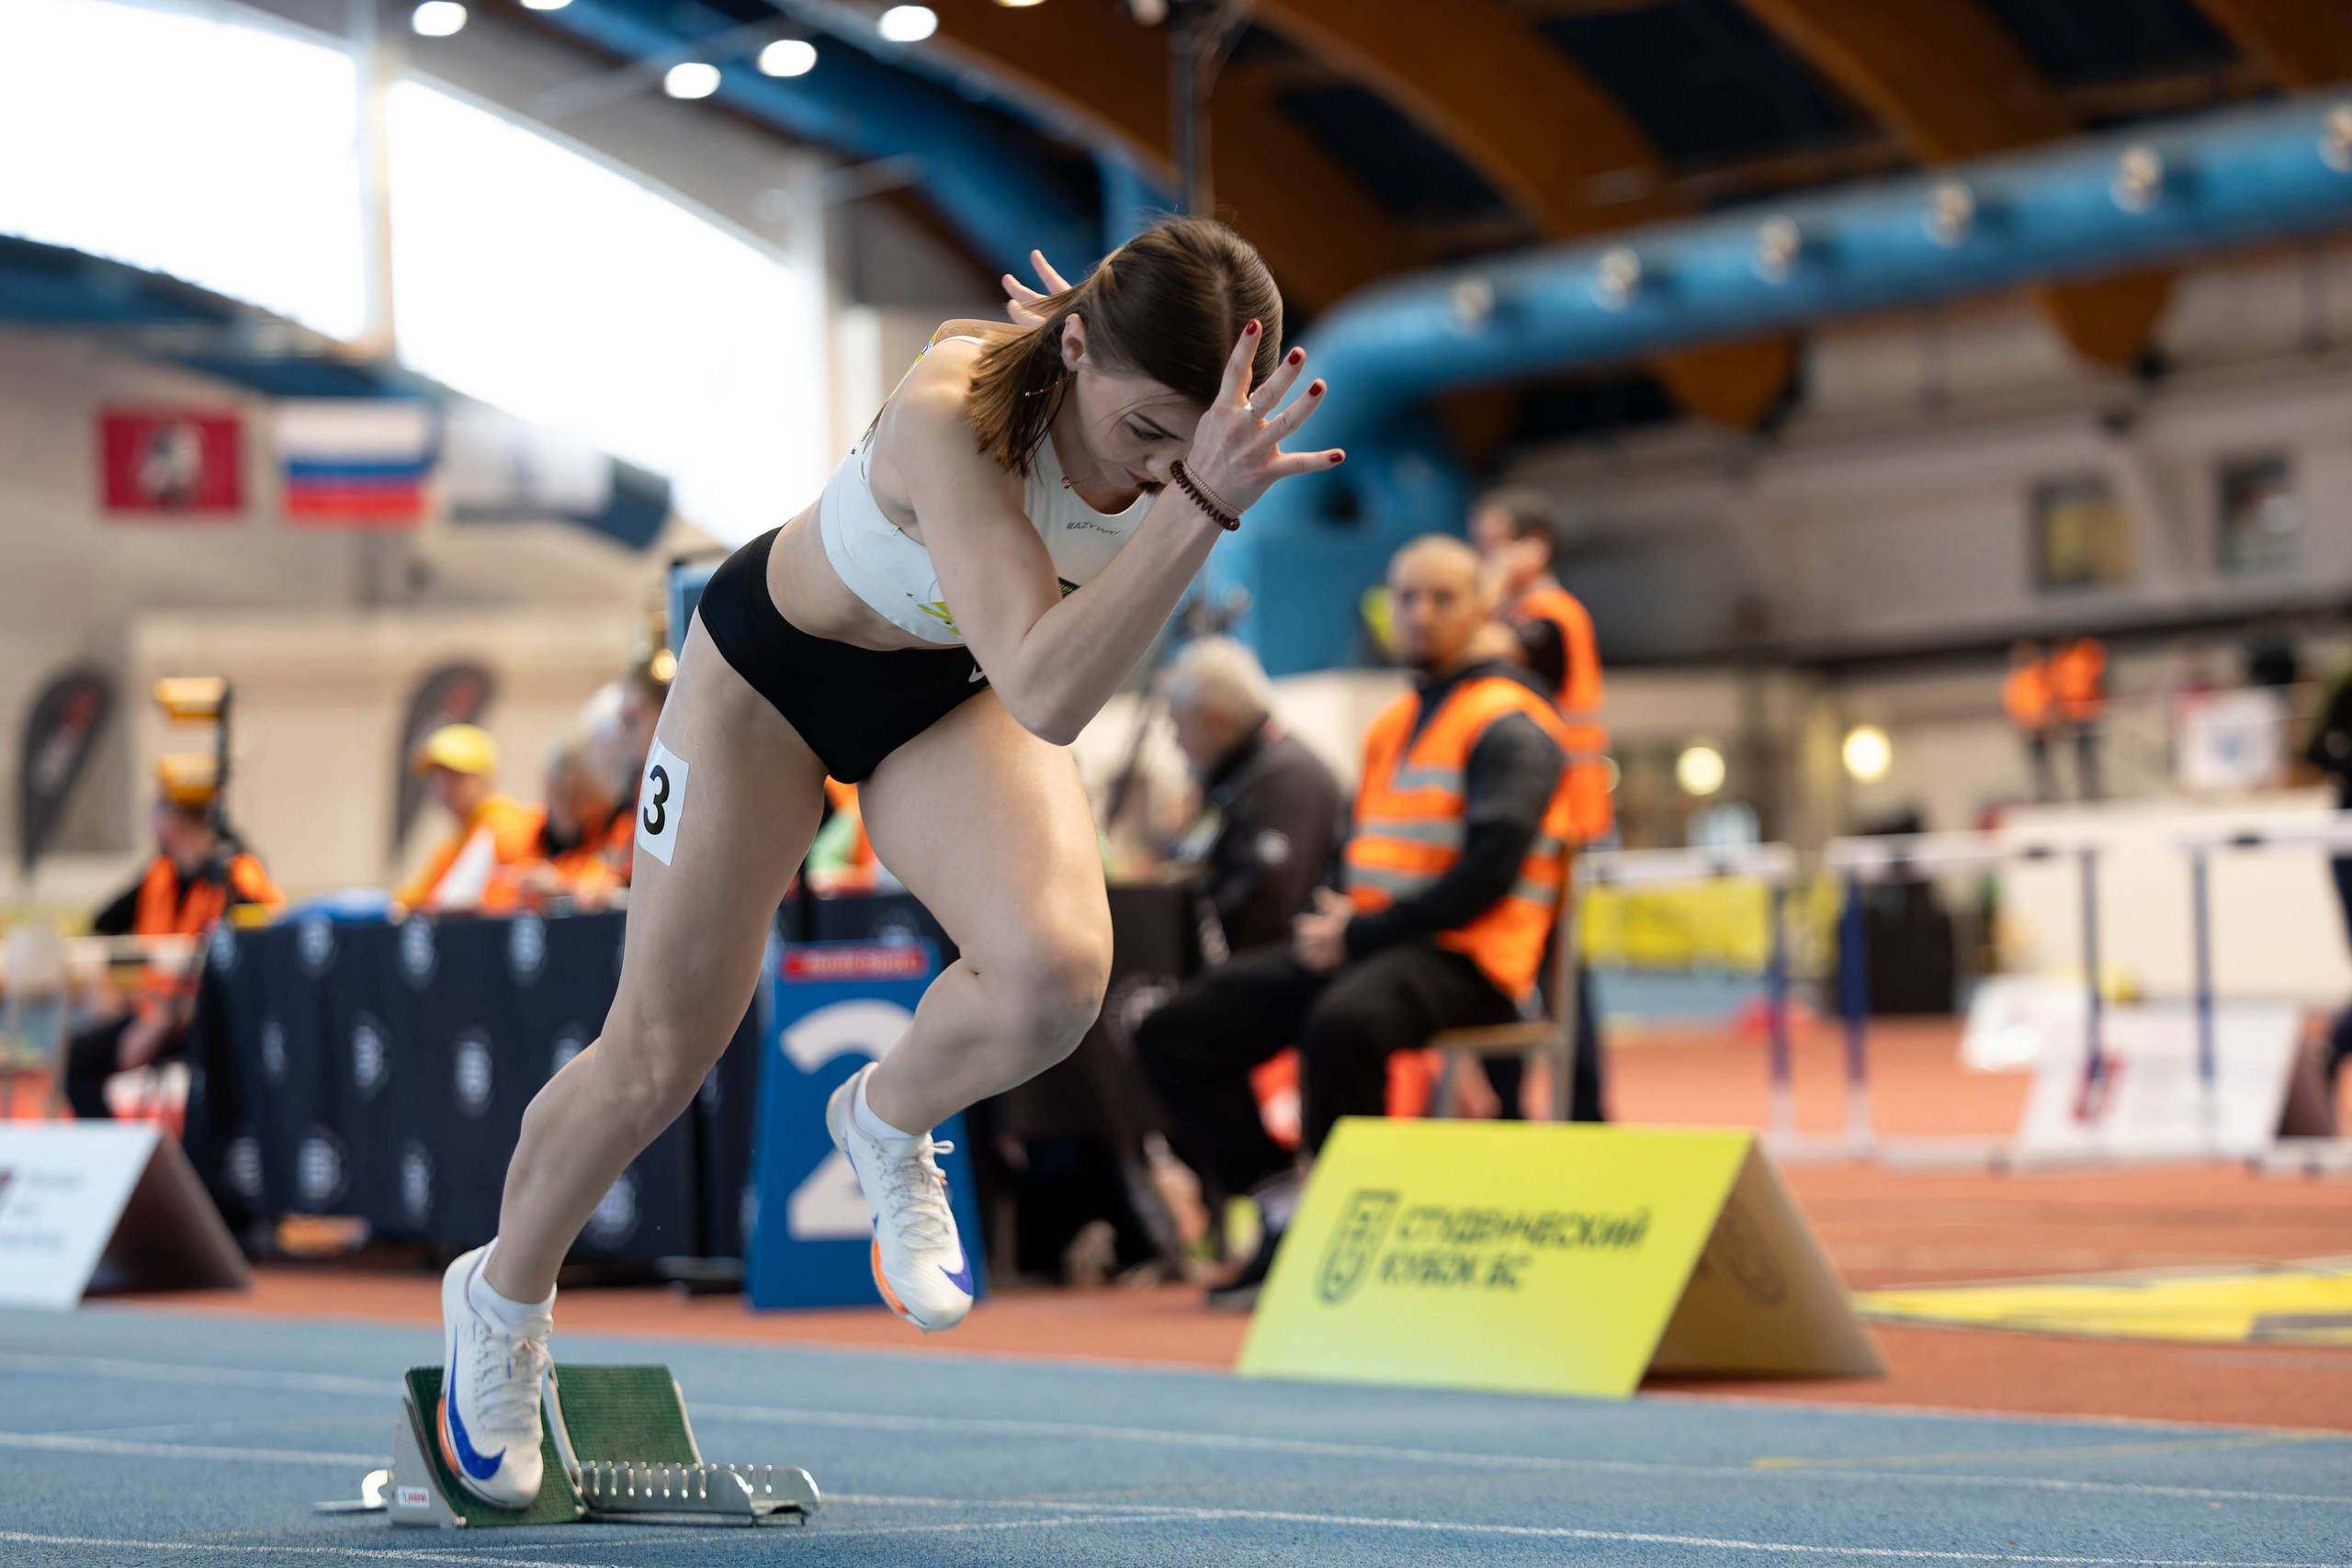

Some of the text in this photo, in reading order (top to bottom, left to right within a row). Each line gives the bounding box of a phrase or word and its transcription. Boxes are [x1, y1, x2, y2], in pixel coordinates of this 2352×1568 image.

[643, 764, 671, 836] 3
[781, 998, 917, 1242] 2
[1396, 1204, 1652, 1253] СТУДЕНЧЕСКИЙ
[1378, 1250, 1478, 1288] КУБОК
